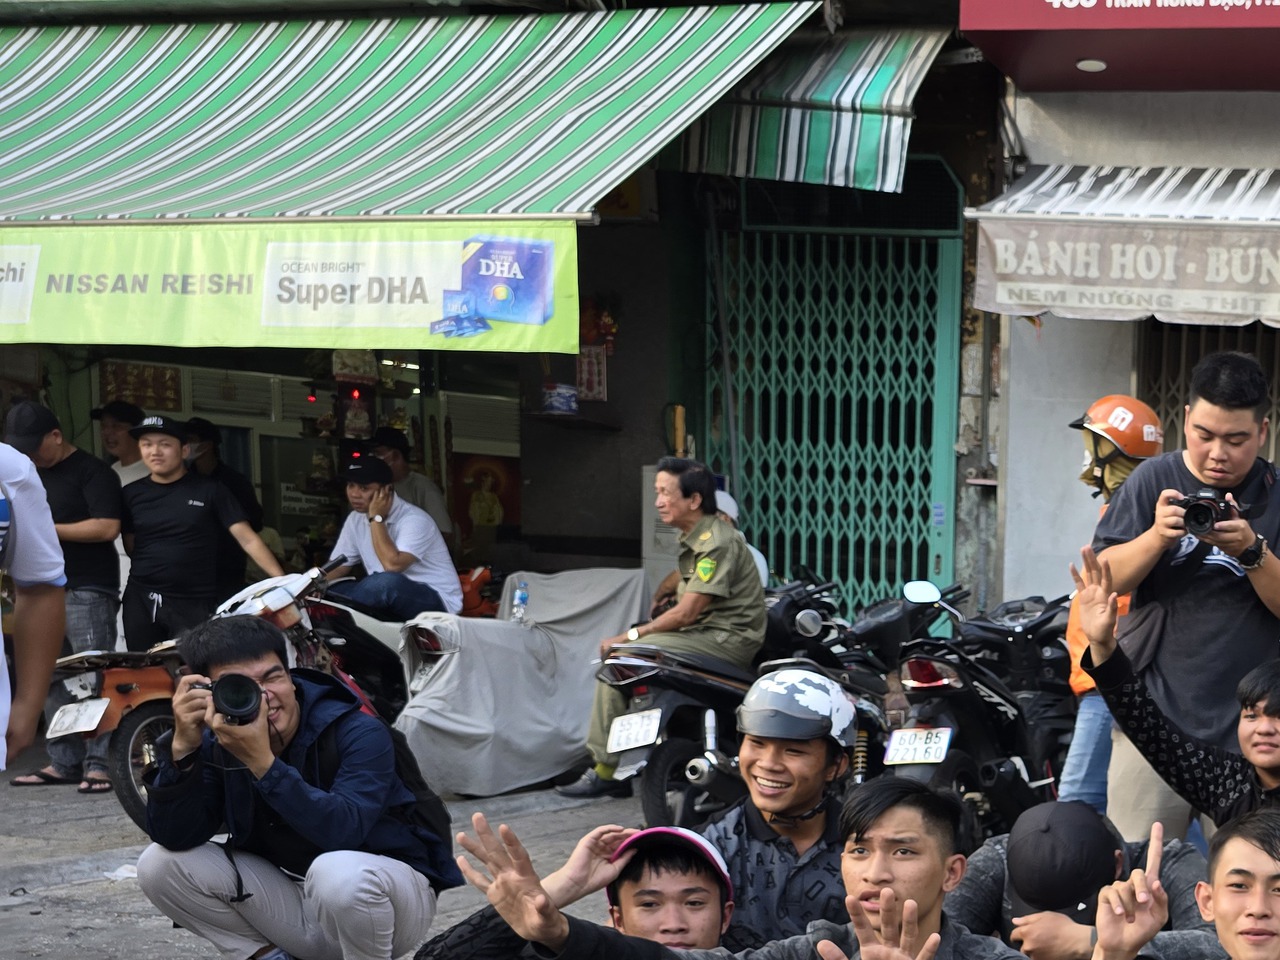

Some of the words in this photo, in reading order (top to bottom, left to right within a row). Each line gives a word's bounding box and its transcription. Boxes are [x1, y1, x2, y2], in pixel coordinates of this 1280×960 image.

[994, 230, 1100, 277] BÁNH
[1111, 231, 1177, 281] HỎI
[281, 262, 319, 273] OCEAN
[479, 259, 524, 279] DHA
[46, 273, 149, 294] NISSAN
[161, 273, 254, 295] REISHI
[277, 276, 361, 311] Super
[367, 276, 429, 304] DHA
[1007, 288, 1067, 304] NEM
[898, 731, 943, 746] 60-B5
